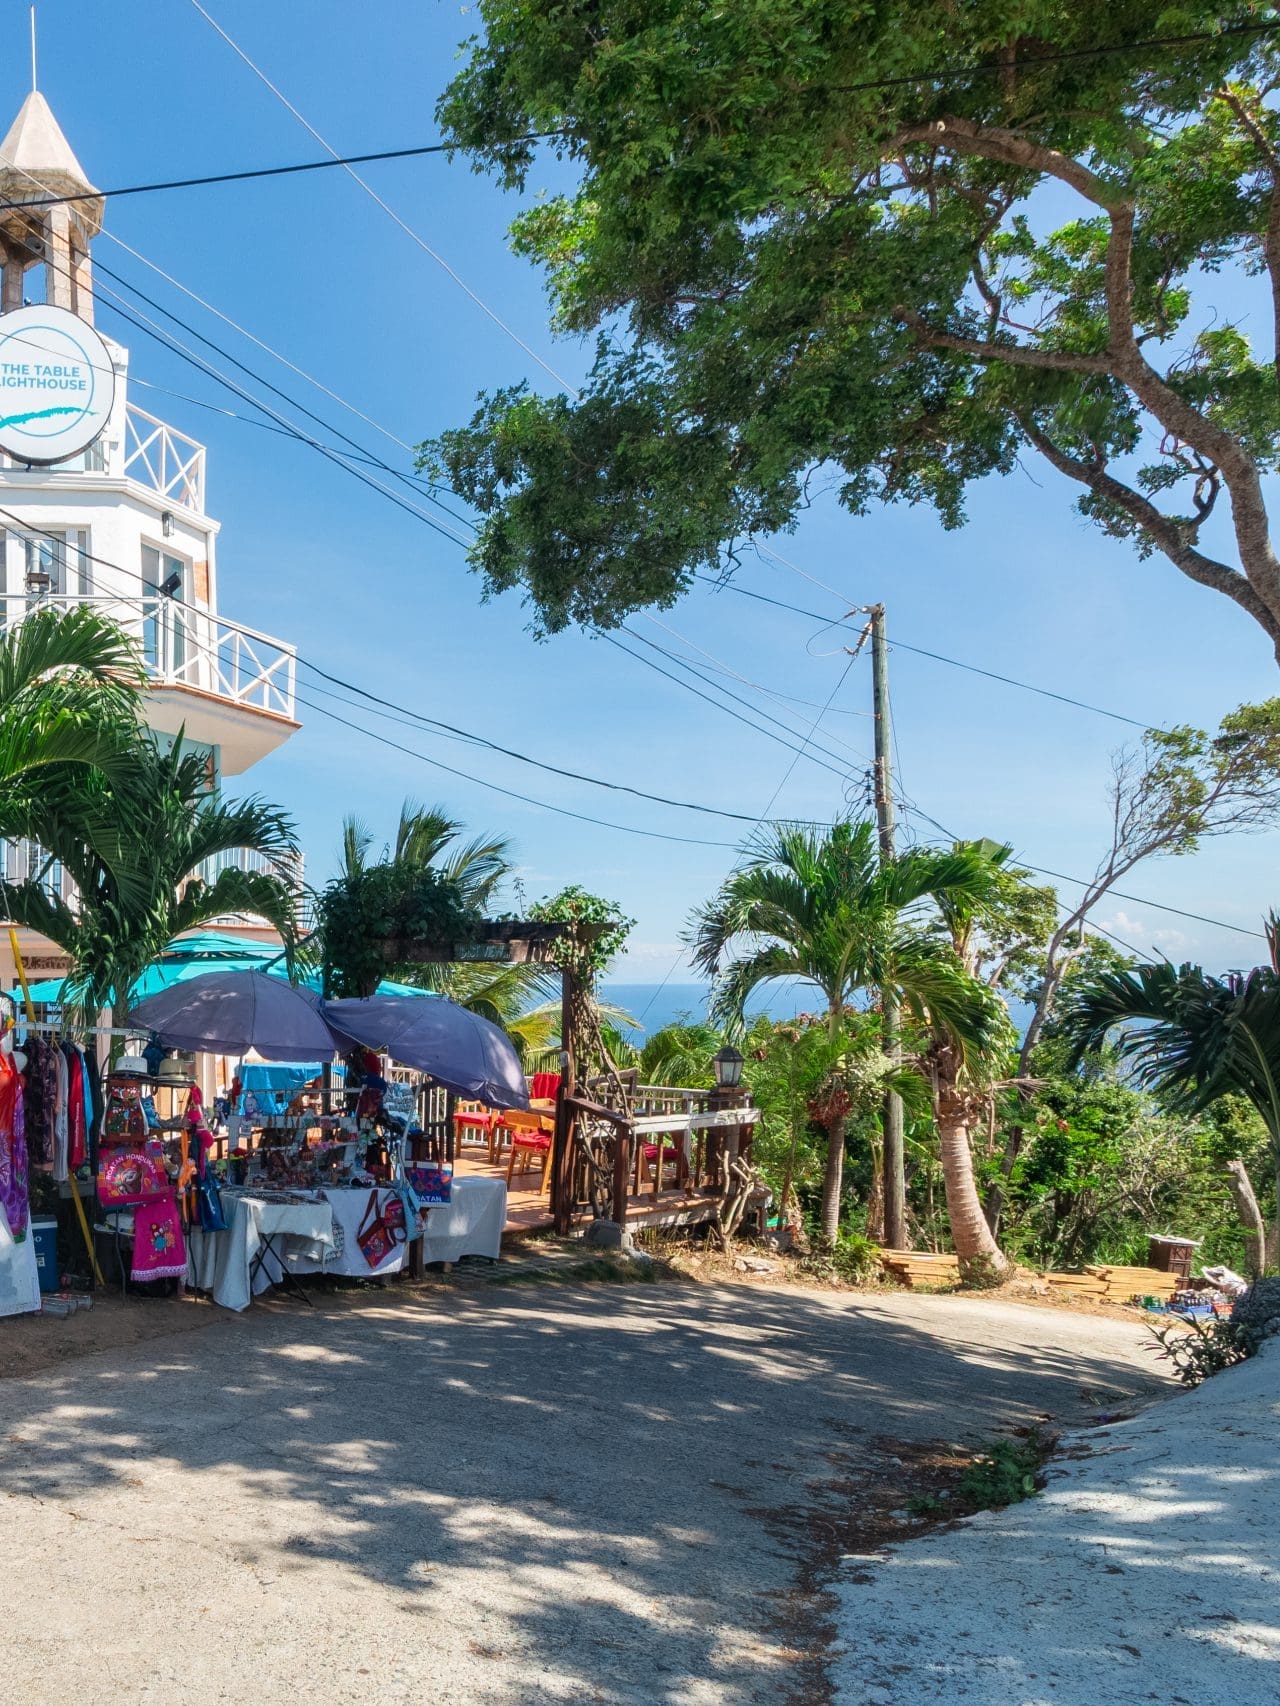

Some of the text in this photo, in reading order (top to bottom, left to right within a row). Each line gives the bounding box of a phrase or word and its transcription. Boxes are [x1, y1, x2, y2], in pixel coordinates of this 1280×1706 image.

[1, 363, 81, 378] THE TABLE
[105, 1153, 157, 1181] ROATAN HONDURAS
